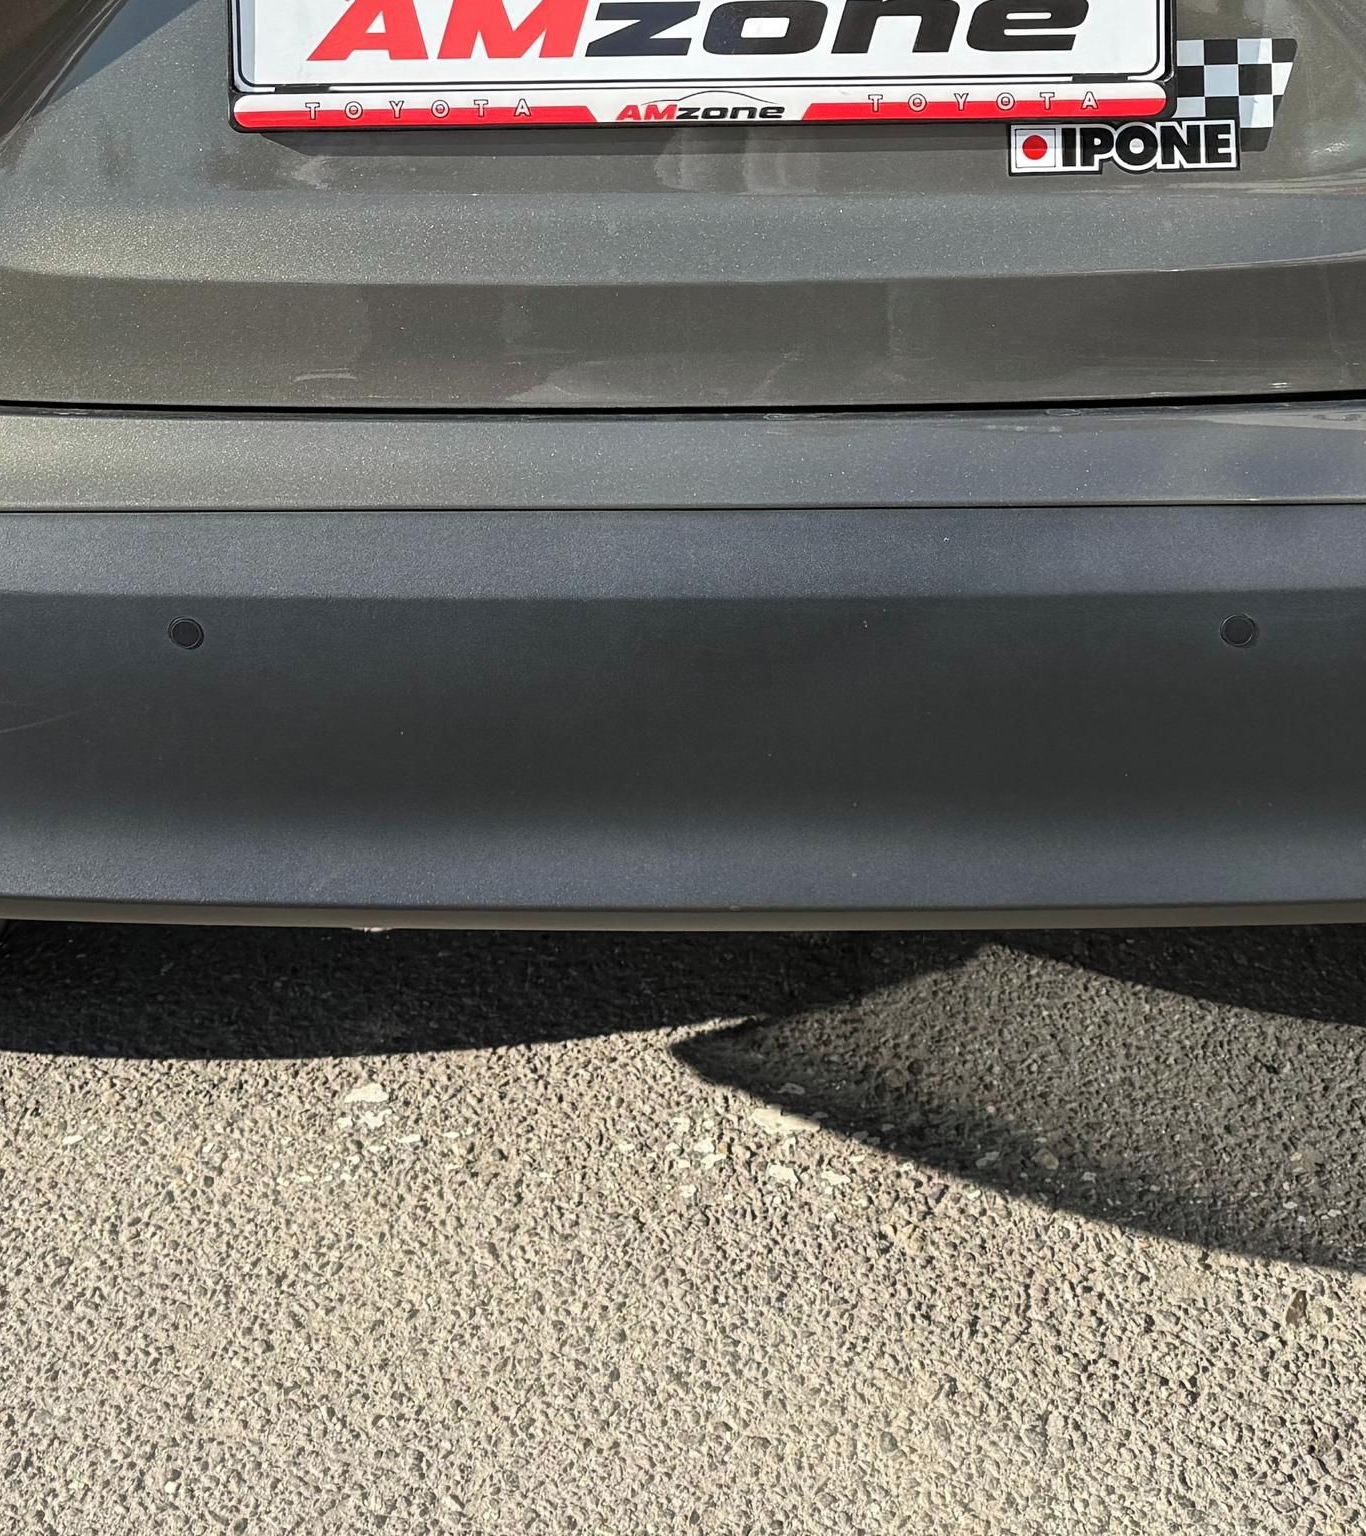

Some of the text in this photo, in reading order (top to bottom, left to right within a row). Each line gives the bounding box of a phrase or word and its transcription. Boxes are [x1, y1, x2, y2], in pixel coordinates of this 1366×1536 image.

[305, 91, 1099, 121] TOYOTA AMzone TOYOTA
[1061, 123, 1233, 168] IPONE
